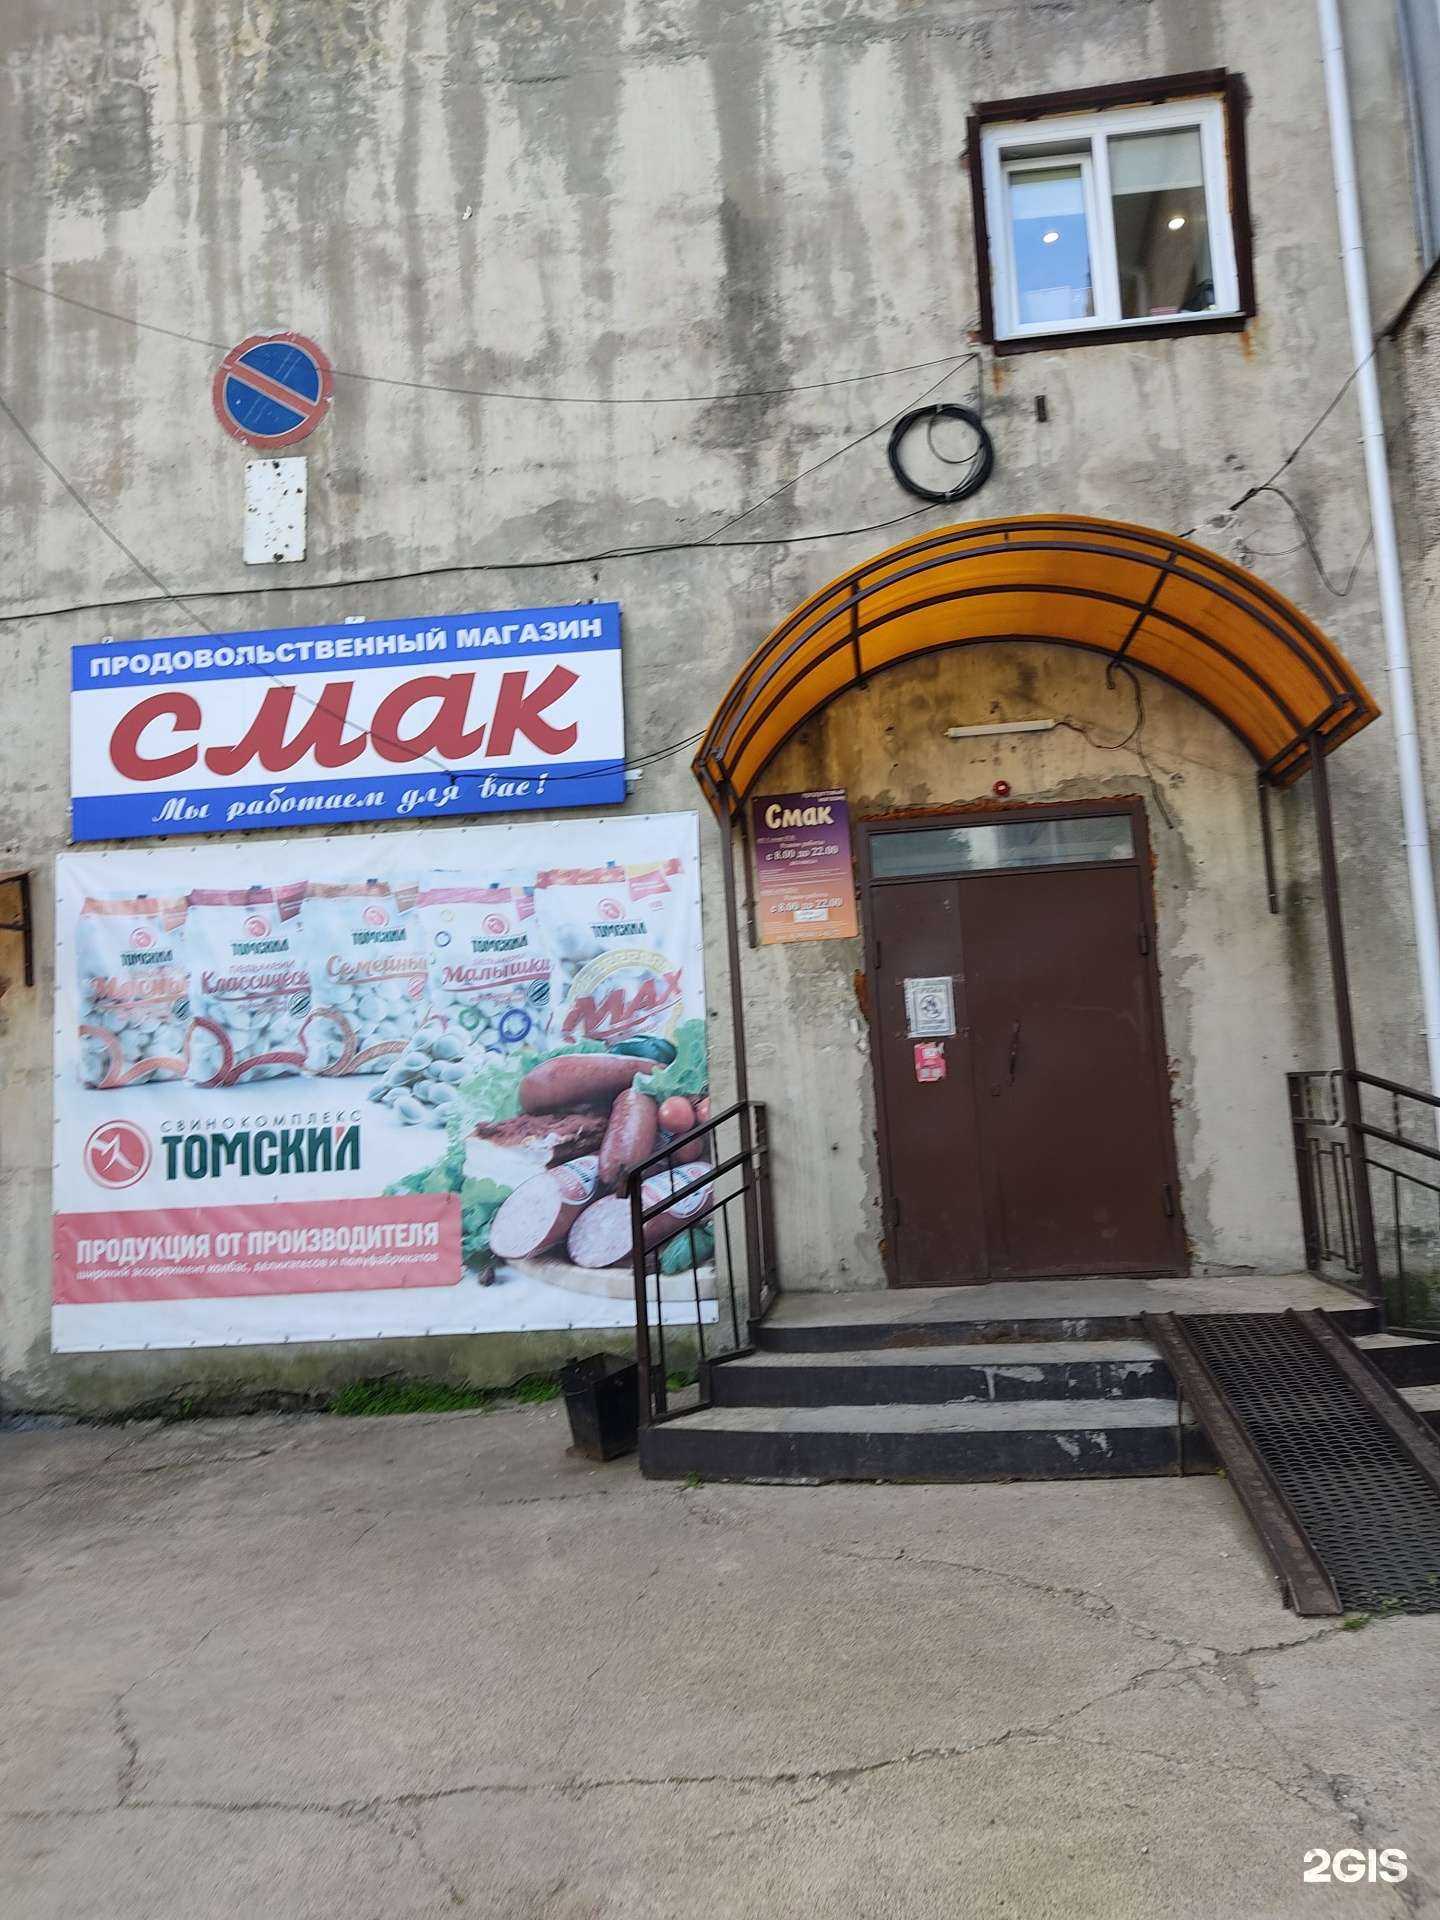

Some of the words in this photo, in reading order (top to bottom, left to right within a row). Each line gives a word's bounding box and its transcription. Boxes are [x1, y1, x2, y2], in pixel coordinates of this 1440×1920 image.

[90, 628, 447, 678] ПРОДОВОЛЬСТВЕННЫЙ
[456, 618, 603, 649] МАГАЗИН
[152, 796, 211, 823] Мы
[226, 786, 387, 823] работаем
[396, 784, 460, 815] для
[478, 772, 550, 800] вас!
[765, 804, 835, 829] Смак
[160, 1109, 362, 1133] СВИНОКОМПЛЕКС
[161, 1125, 361, 1180] ТОМСКИЙ
[76, 1232, 211, 1266] ПРОДУКЦИЯ
[215, 1231, 244, 1258] ОТ
[247, 1222, 440, 1255] ПРОИЗВОДИТЕЛЯ
